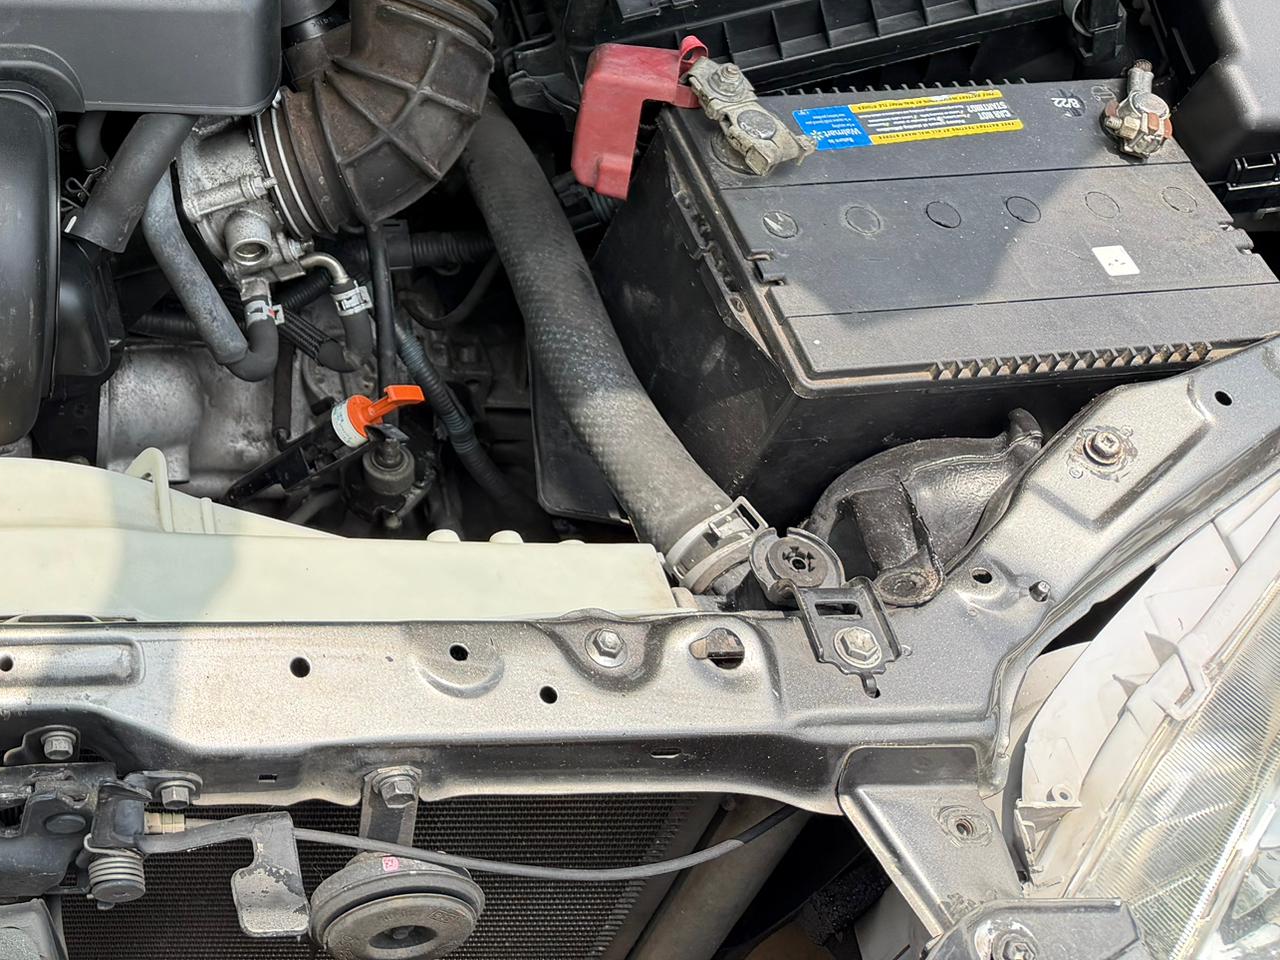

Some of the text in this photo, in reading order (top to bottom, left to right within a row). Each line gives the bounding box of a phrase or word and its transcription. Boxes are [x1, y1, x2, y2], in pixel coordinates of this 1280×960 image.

[965, 101, 1008, 114] STARTING?
[977, 112, 992, 120] NOT
[992, 110, 1012, 120] CAR
[822, 128, 861, 138] Walmart
